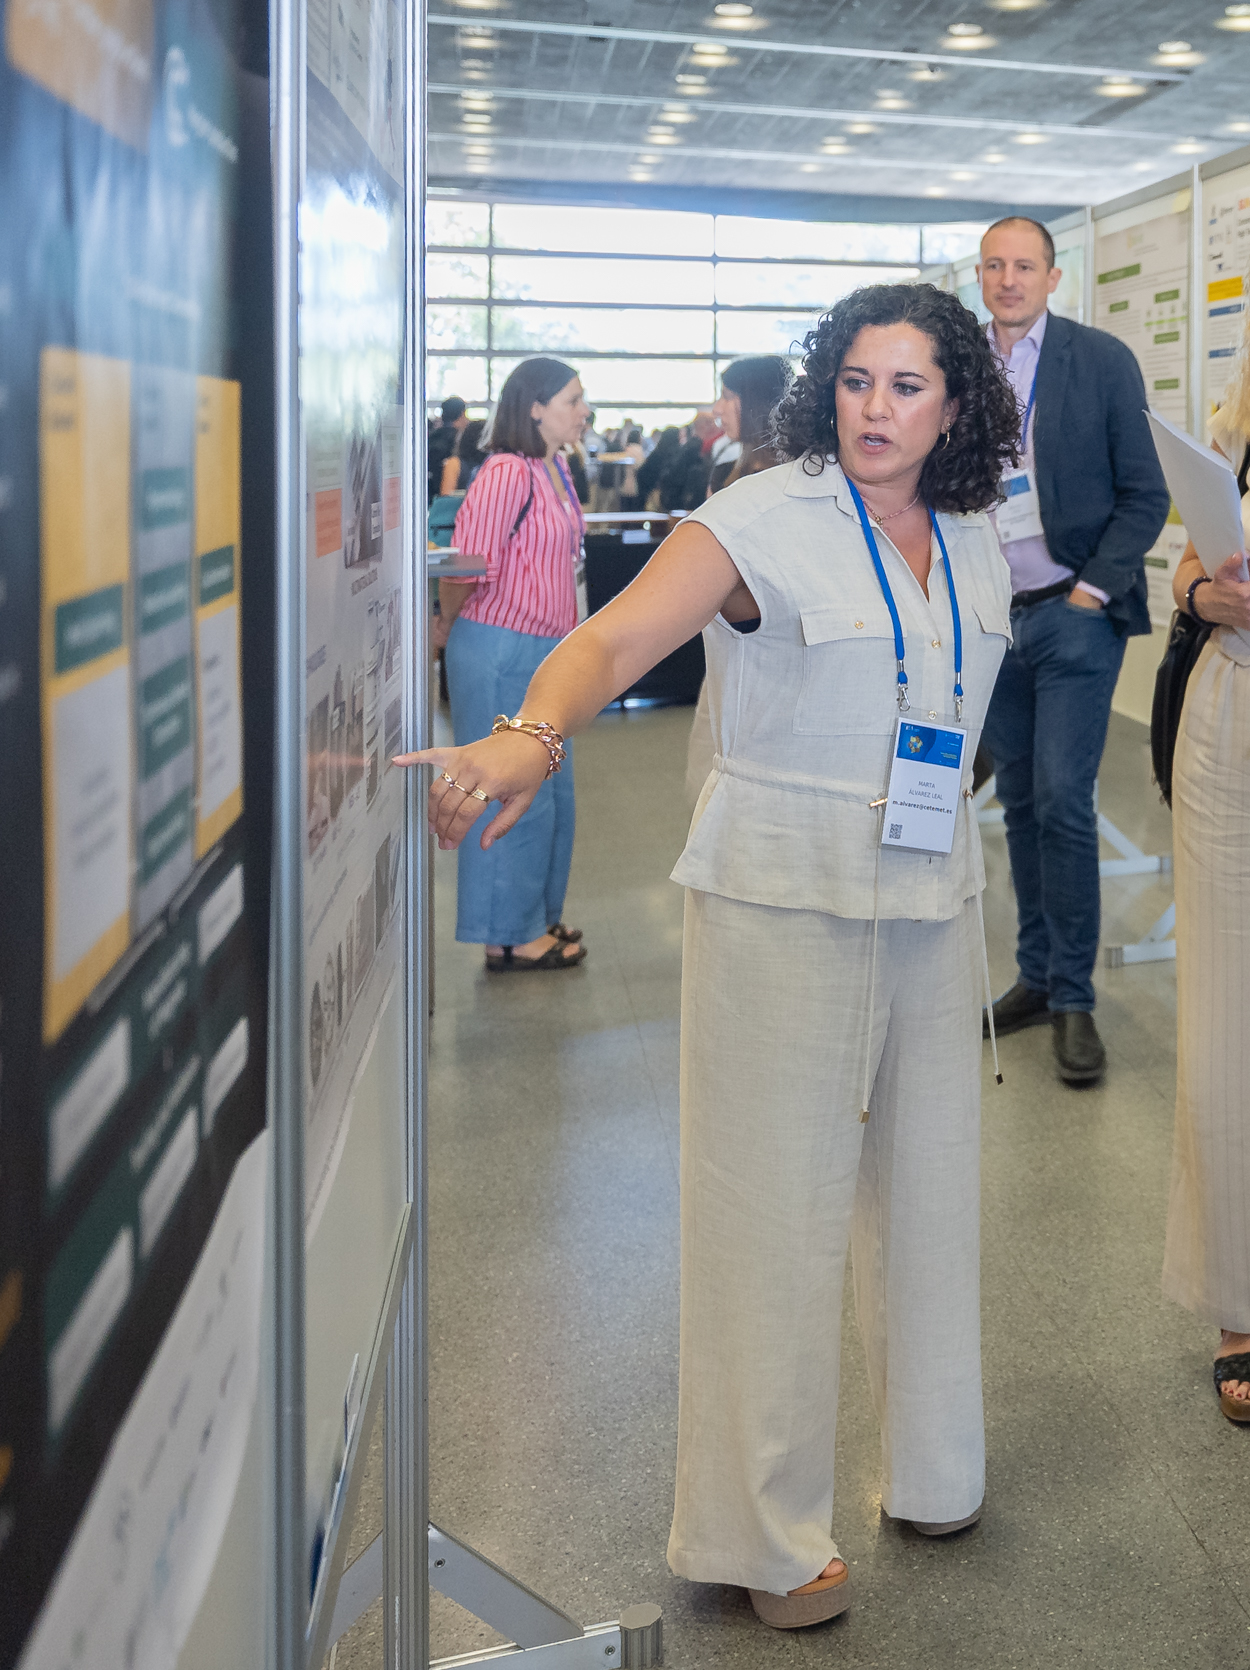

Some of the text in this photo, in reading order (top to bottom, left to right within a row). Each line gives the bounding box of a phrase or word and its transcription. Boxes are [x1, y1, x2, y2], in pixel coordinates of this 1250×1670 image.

[918, 781, 935, 789] MARTA
[908, 788, 931, 798] ÁLVAREZ
[892, 800, 952, 814] m.alvarez@cetemet.es
